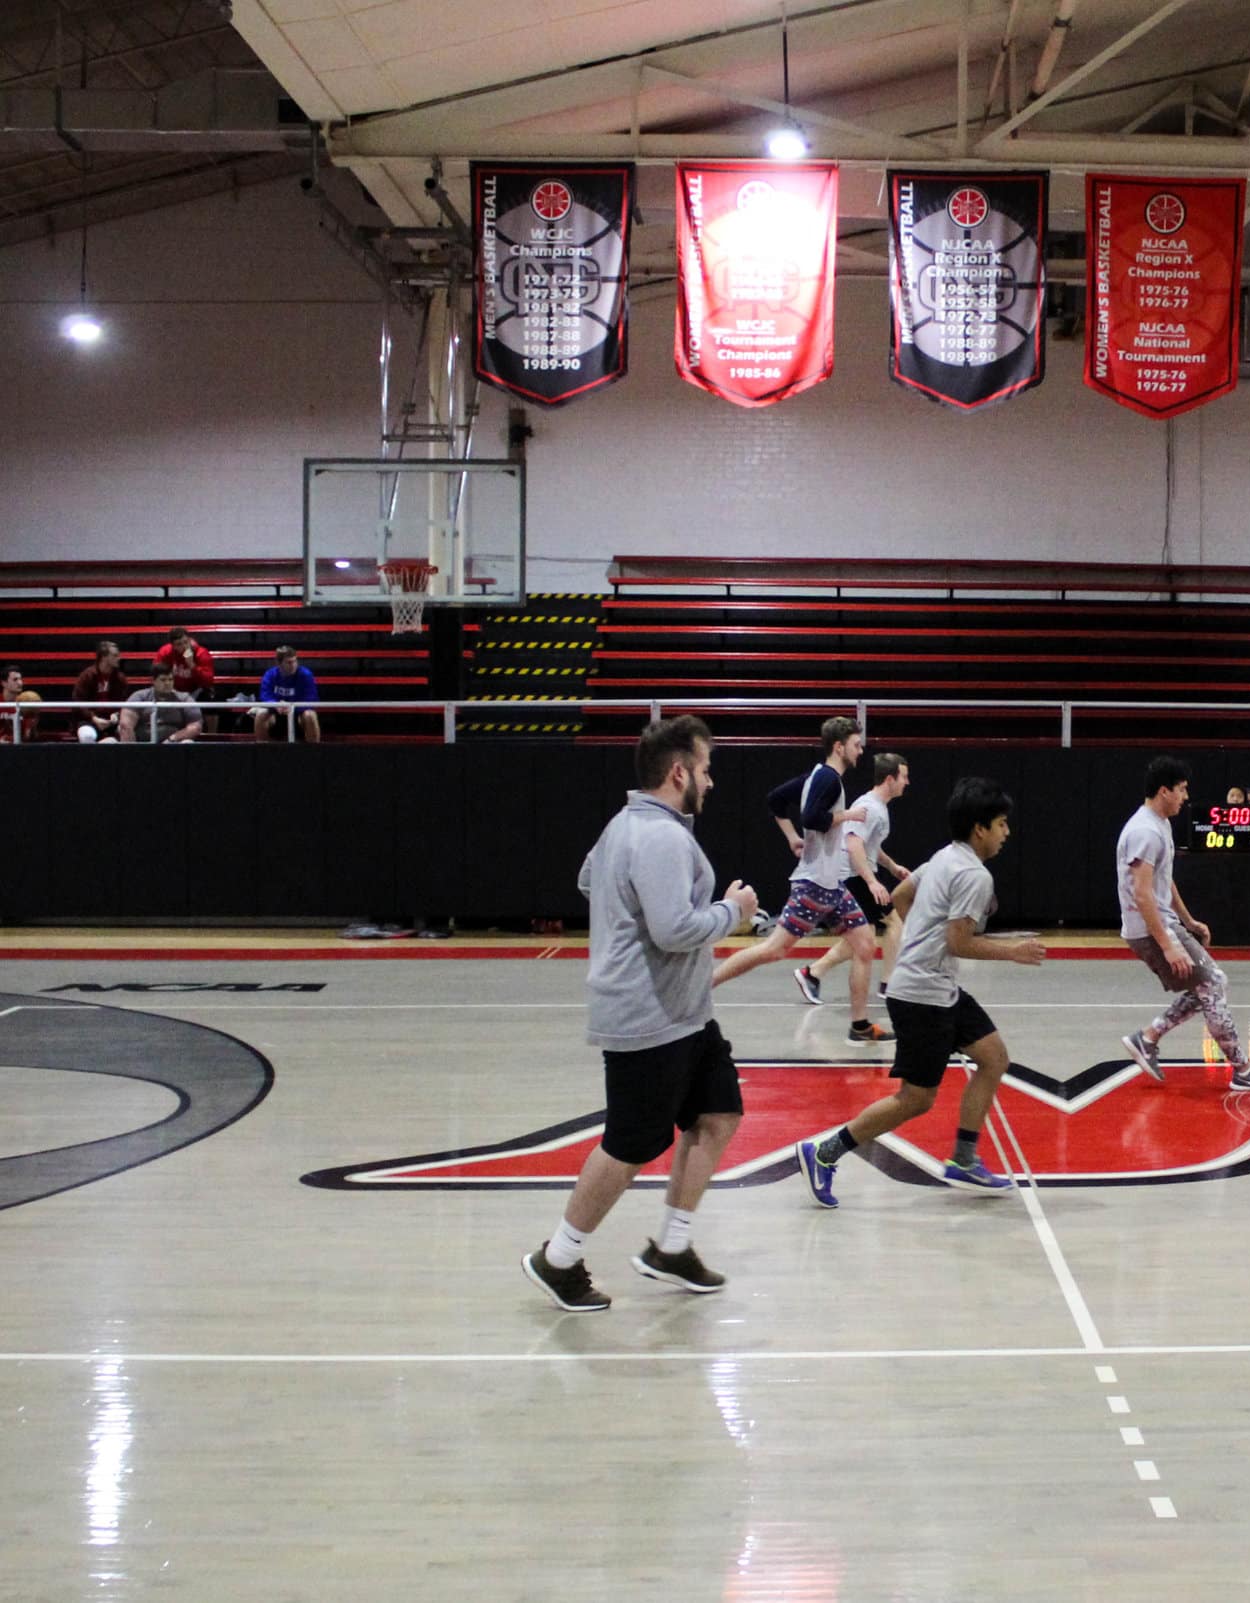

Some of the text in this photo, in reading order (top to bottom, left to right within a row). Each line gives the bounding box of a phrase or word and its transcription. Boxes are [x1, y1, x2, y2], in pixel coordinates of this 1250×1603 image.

[483, 176, 497, 283] BASKETBALL
[900, 182, 914, 290] BASKETBALL
[942, 239, 995, 250] NJCAA
[1141, 239, 1188, 250] NJCAA
[509, 244, 593, 259] Champions
[934, 252, 1003, 267] Region X
[1136, 252, 1194, 266] Region X
[926, 264, 1009, 281] Champions
[1128, 266, 1201, 281] Champions
[1096, 186, 1112, 378] WOMEN'S BASKETBALL
[1140, 285, 1190, 296] 1975-76
[1140, 297, 1188, 308] 1976-77
[1139, 322, 1186, 333] NJCAA
[714, 332, 797, 346] Tournament
[1133, 336, 1190, 349] National
[717, 349, 793, 364] Champions
[524, 359, 581, 370] 1989-90
[730, 367, 781, 379] 1985-86
[1136, 368, 1188, 380] 1975-76
[1136, 381, 1187, 393] 1976-77
[1210, 807, 1250, 825] 5:00
[1194, 824, 1214, 832] HOME
[39, 983, 328, 992] NCAA
